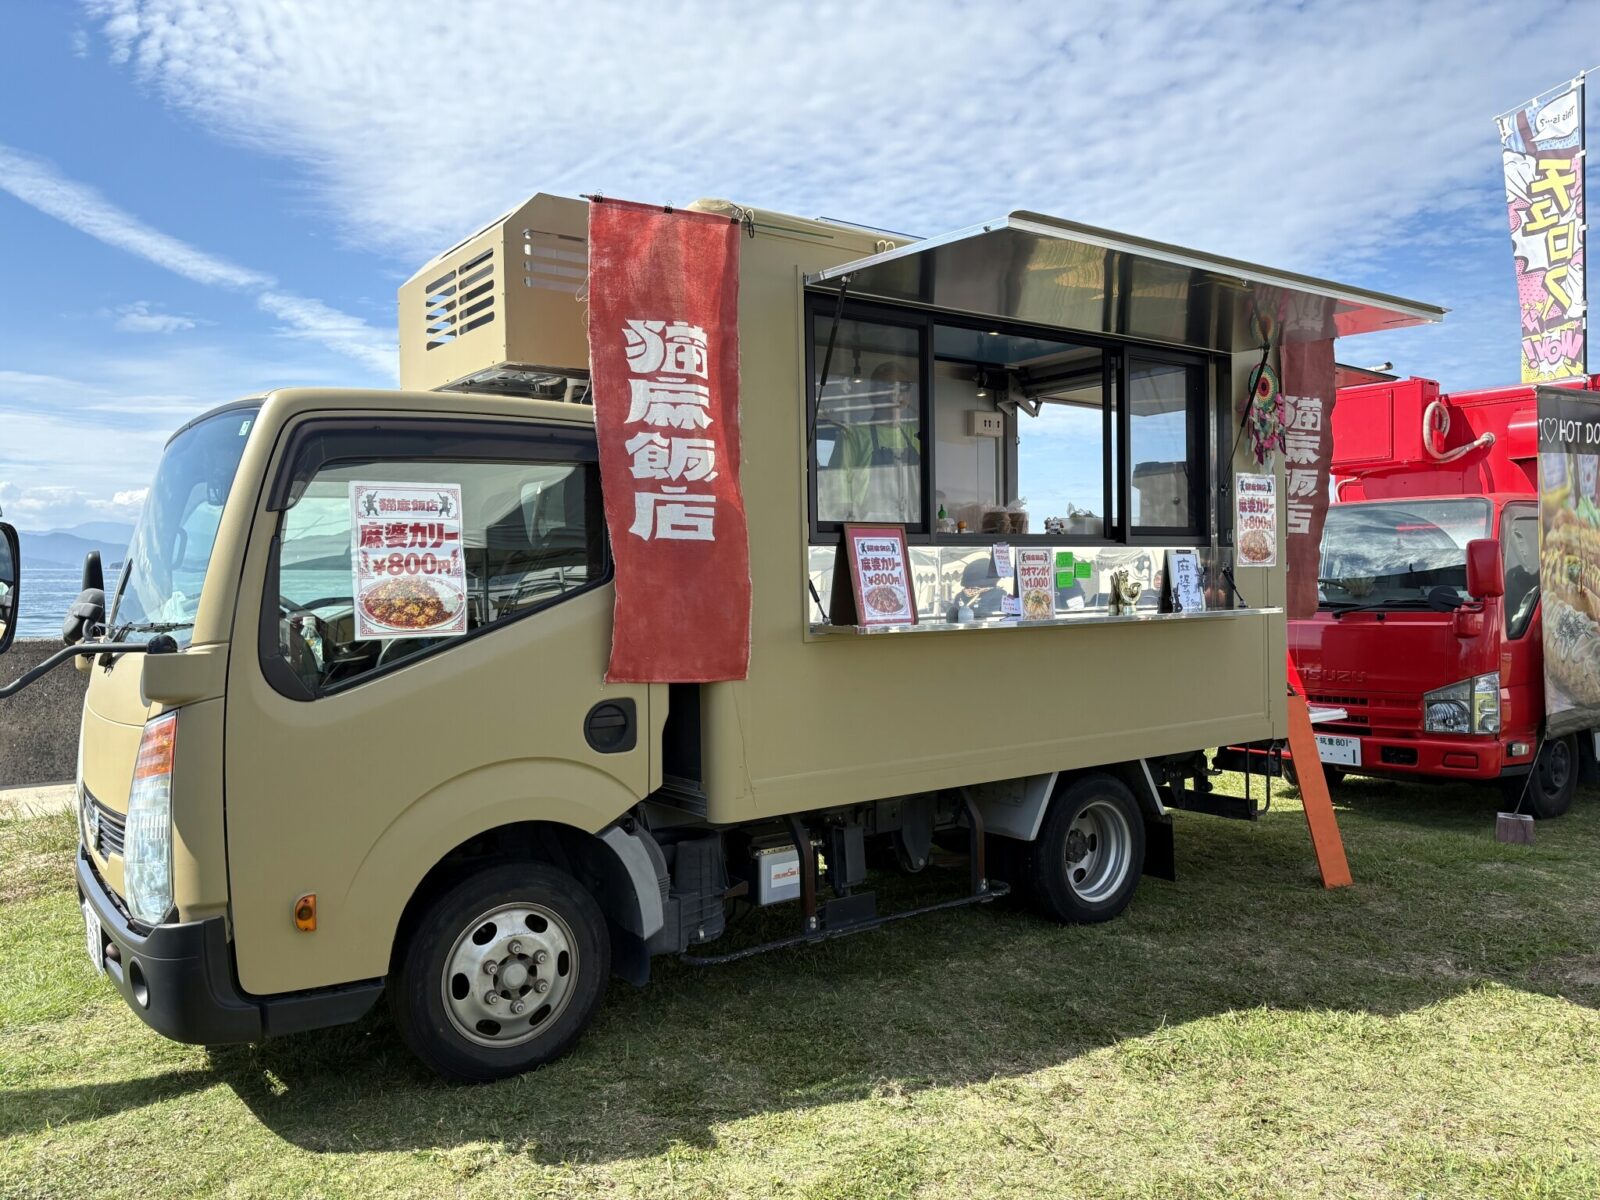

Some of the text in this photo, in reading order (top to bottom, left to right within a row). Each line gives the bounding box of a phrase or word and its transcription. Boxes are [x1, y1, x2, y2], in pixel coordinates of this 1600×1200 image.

[621, 318, 719, 541] 猫麻飯店
[1559, 419, 1582, 443] HOT
[1238, 497, 1274, 514] 麻婆カリー
[359, 522, 459, 549] 麻婆カリー
[372, 553, 451, 576] ¥800円
[860, 557, 901, 571] 麻婆カリー
[1303, 667, 1366, 682] ISUZU
